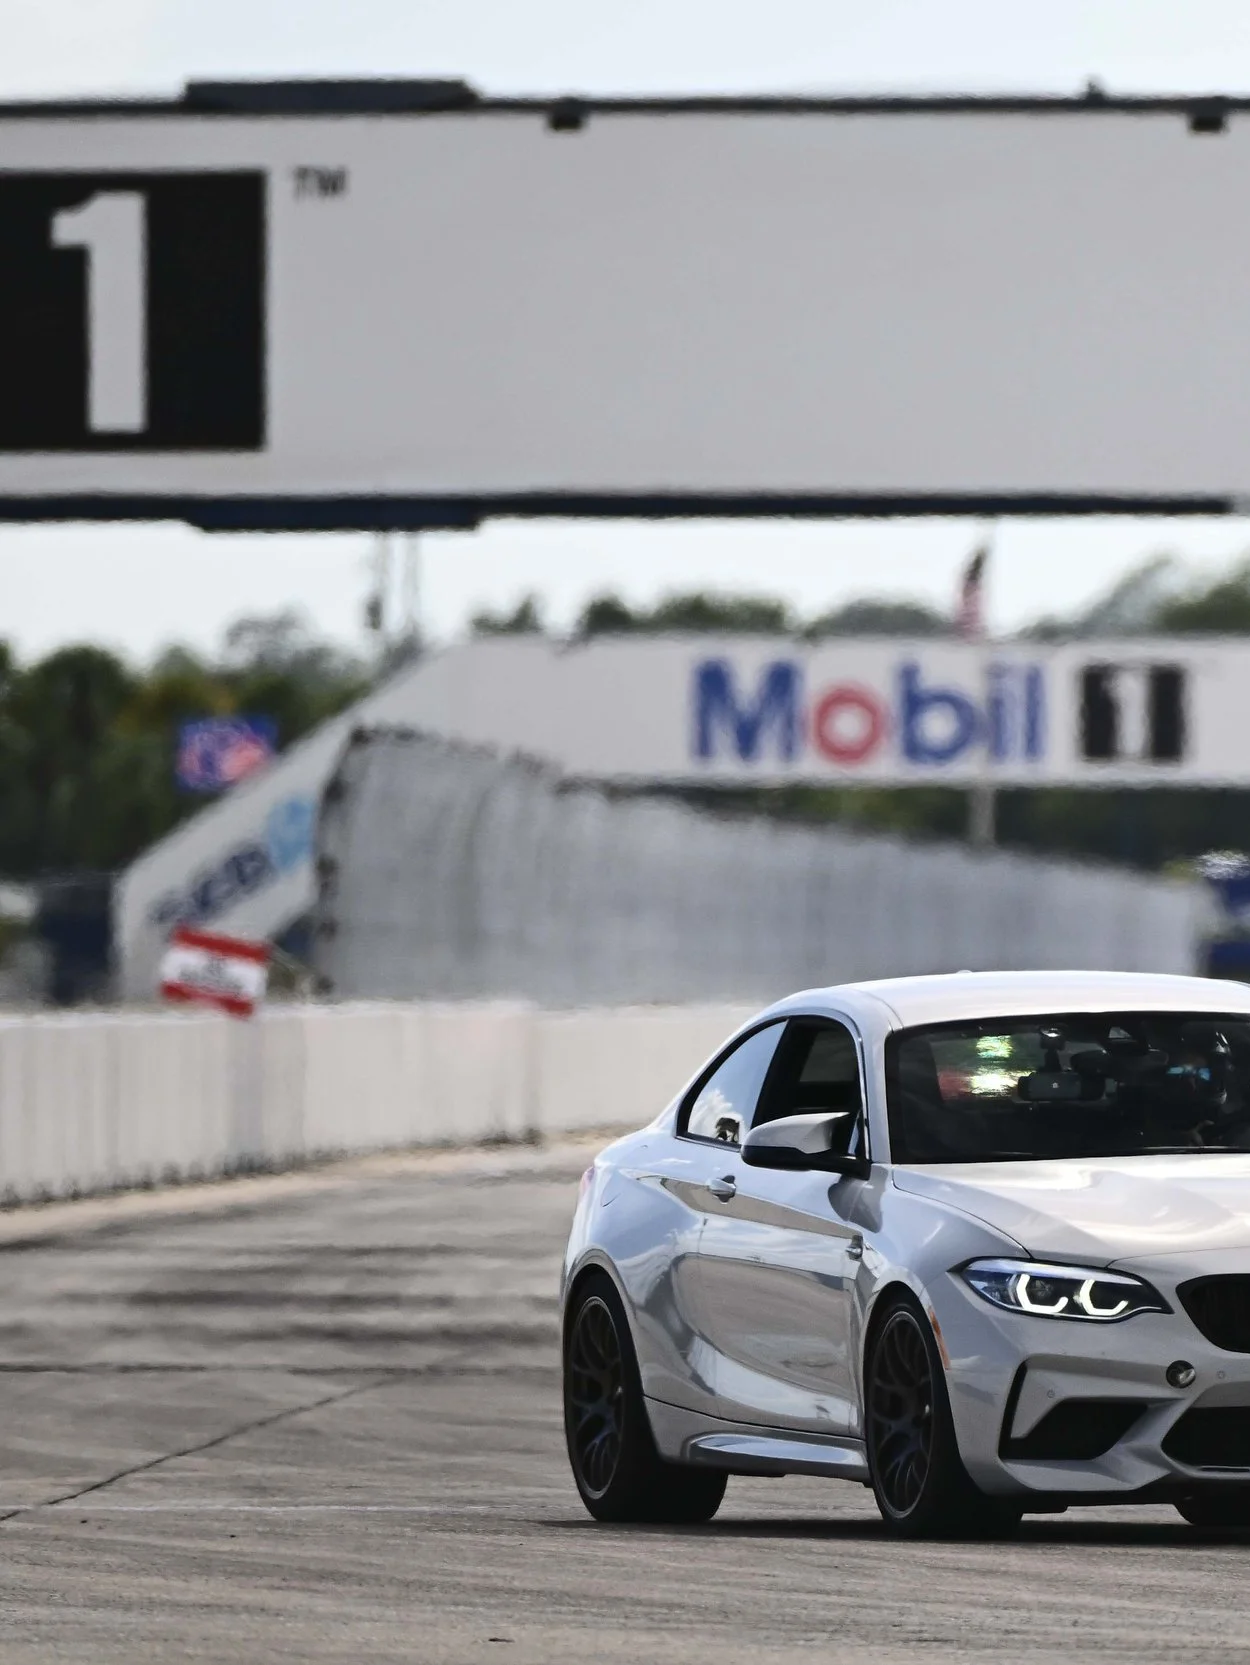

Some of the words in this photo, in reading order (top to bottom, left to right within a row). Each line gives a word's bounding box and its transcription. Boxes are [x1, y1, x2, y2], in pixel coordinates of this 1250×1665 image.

[50, 189, 148, 433] 1
[692, 656, 1044, 765] Mobil
[1109, 669, 1150, 761] 1
